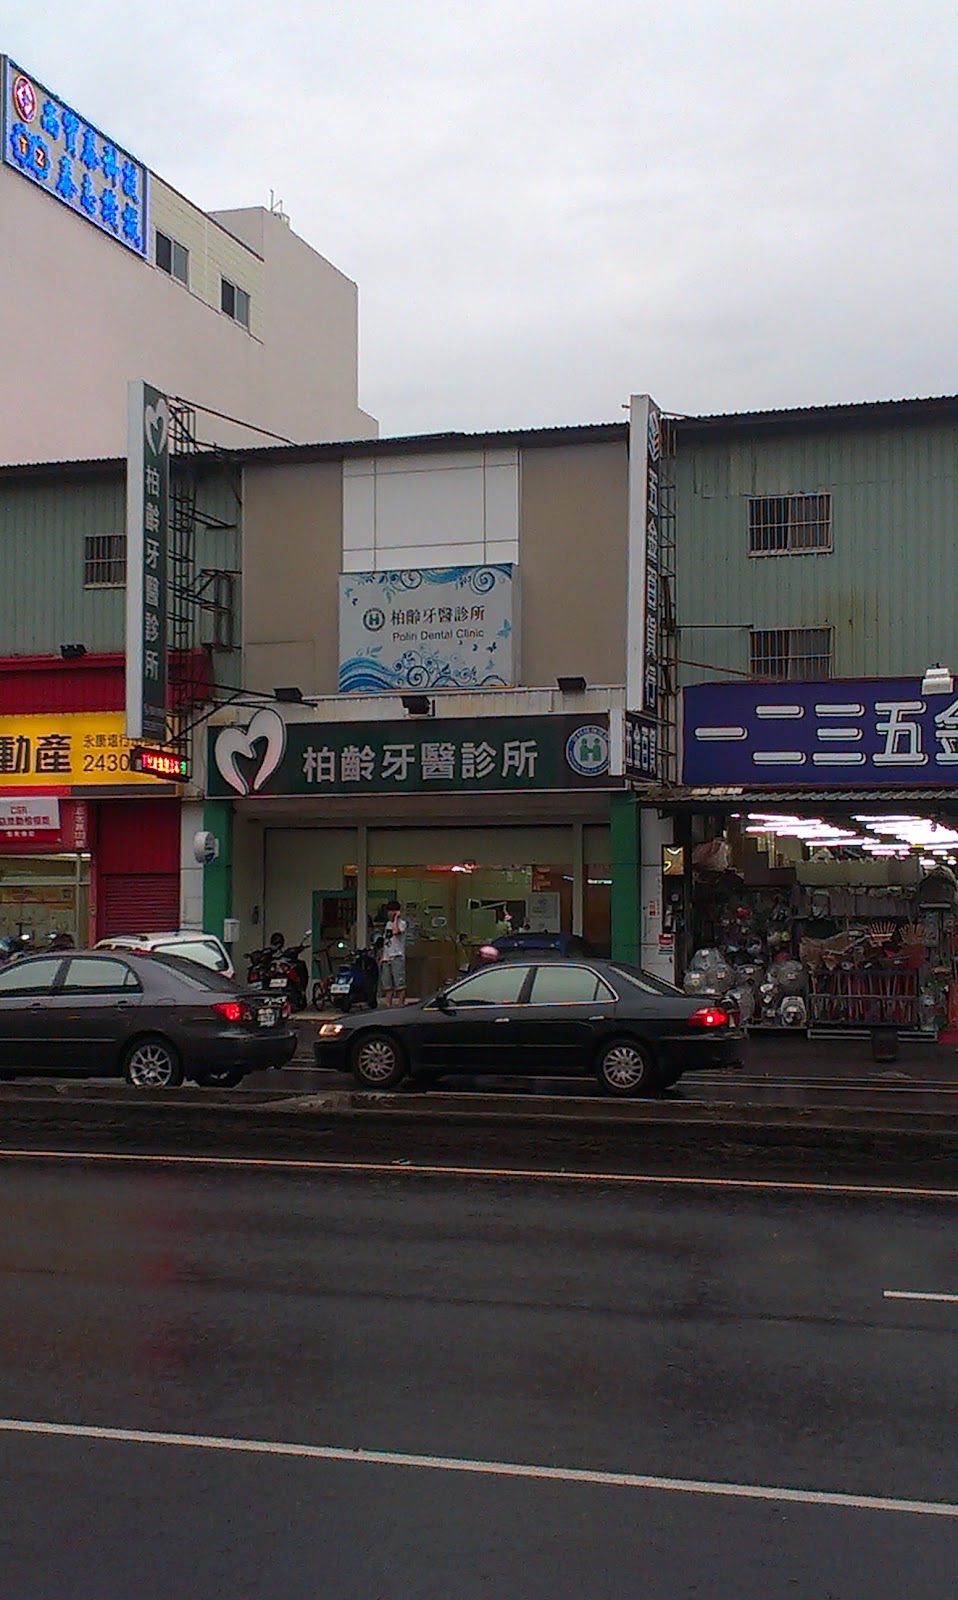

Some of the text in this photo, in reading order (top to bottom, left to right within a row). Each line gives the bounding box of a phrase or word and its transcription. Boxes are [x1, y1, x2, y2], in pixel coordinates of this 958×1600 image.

[390, 605, 486, 626] 柏齡牙醫診所
[392, 627, 485, 642] Polin Dental Clinic
[302, 740, 539, 784] 柏齡牙醫診所
